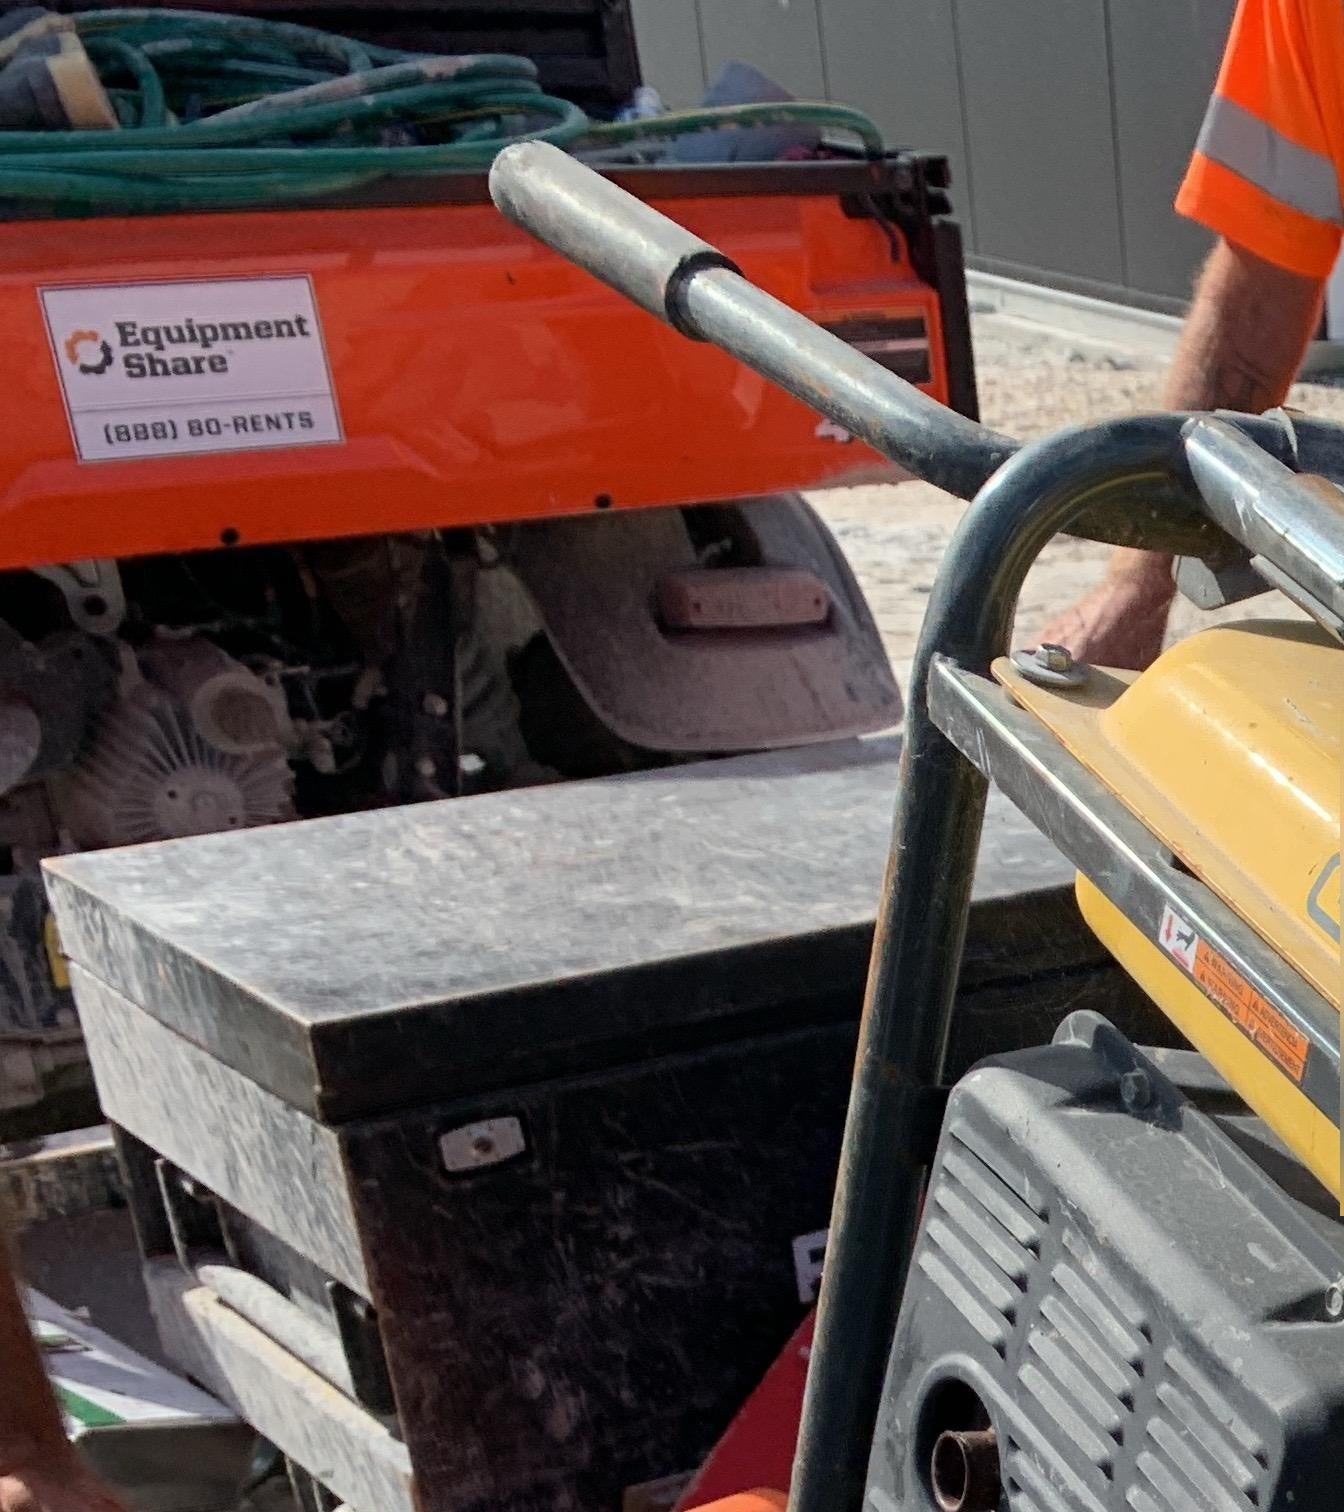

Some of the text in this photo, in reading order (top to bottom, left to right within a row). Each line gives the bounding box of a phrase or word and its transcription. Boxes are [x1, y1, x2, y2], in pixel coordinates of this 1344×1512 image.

[115, 314, 309, 350] Equipment
[122, 351, 229, 379] Share
[104, 420, 178, 445] (888)
